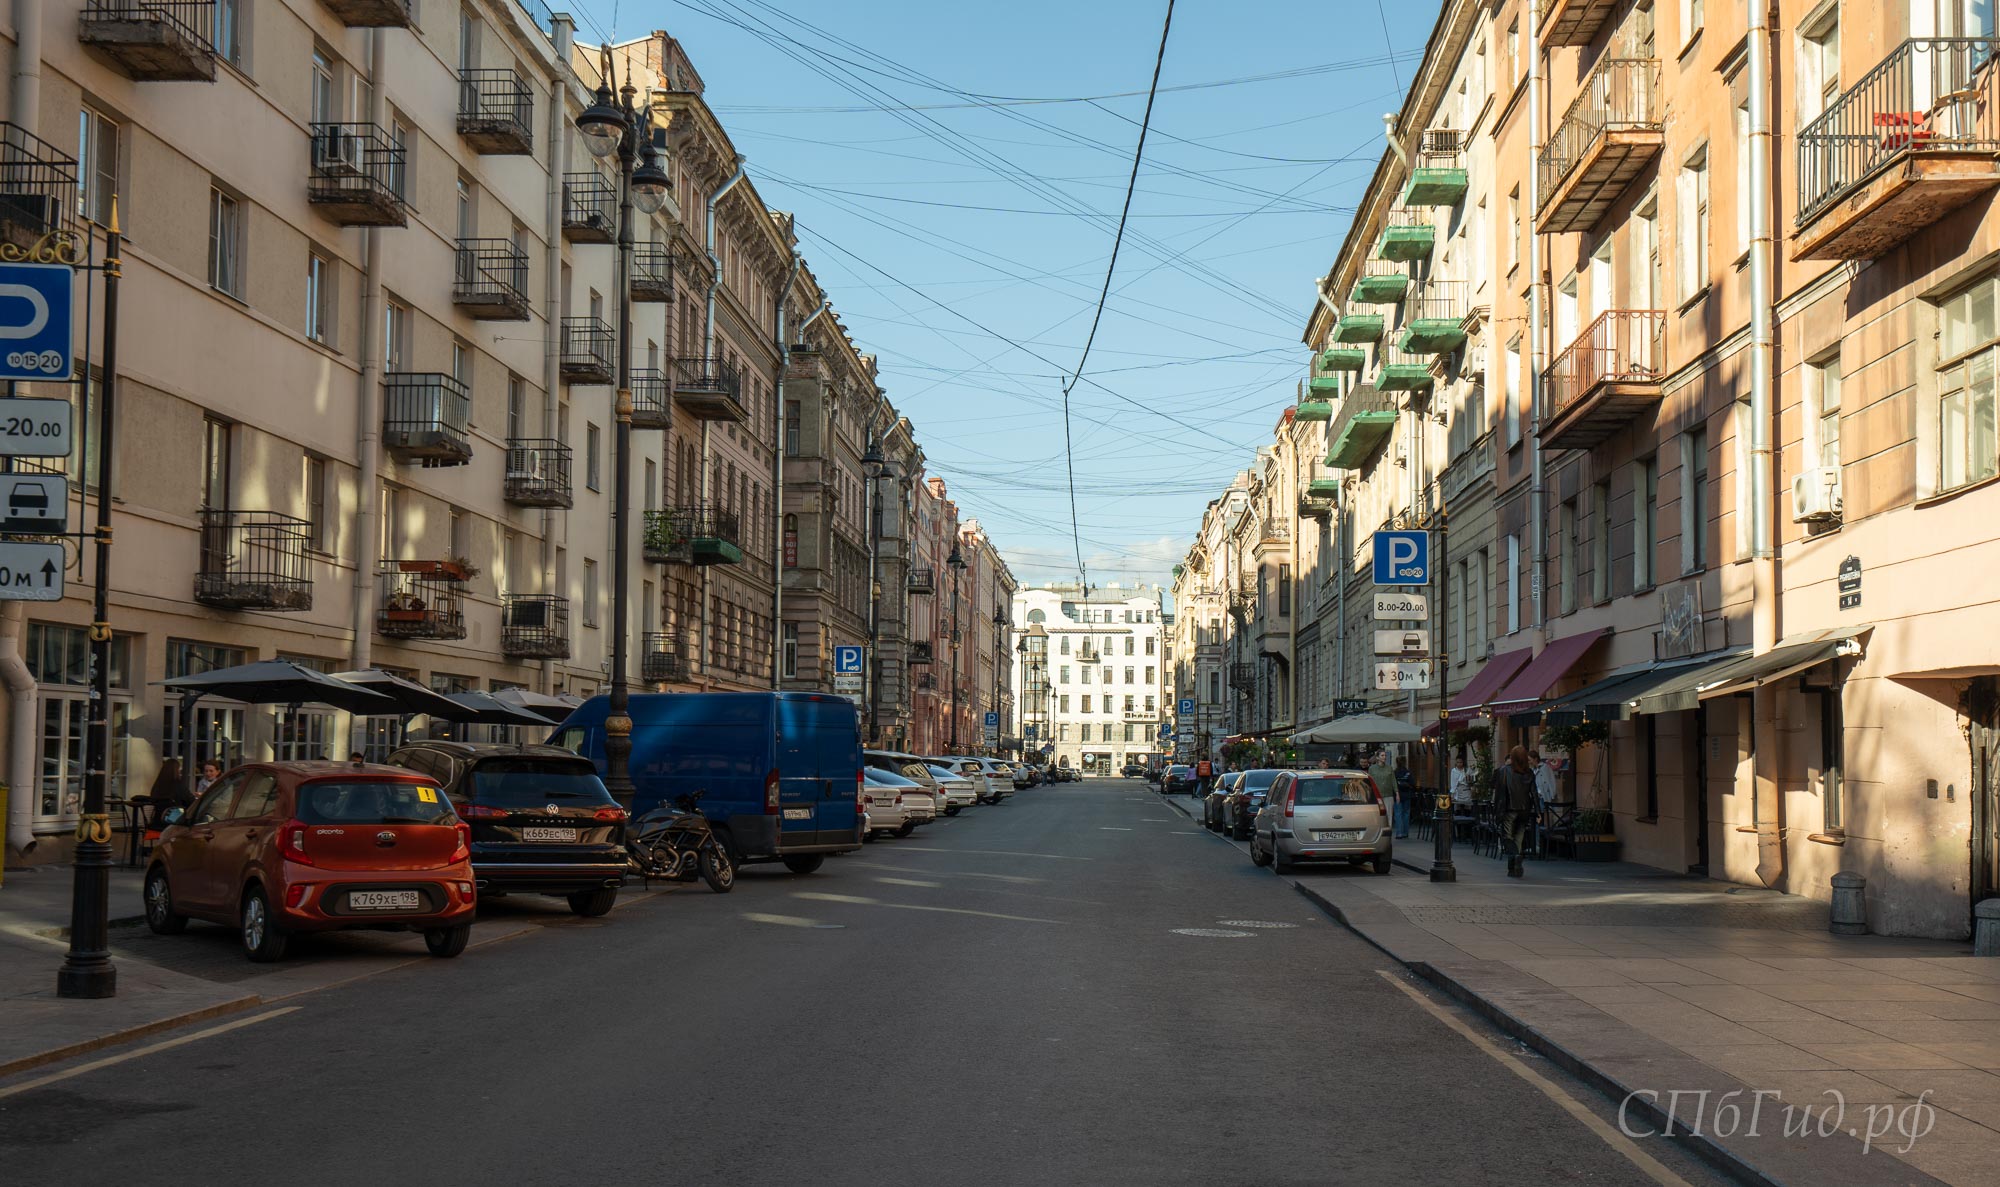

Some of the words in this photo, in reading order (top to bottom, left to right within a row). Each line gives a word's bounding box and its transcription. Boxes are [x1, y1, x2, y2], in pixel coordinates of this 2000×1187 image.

[10, 355, 20, 364] 10
[24, 355, 36, 366] 15
[41, 354, 60, 368] 20
[1389, 537, 1418, 579] P
[1377, 601, 1424, 612] 8.00-20.00
[843, 649, 858, 670] P
[354, 893, 398, 906] К769ХЕ
[400, 892, 416, 901] 198
